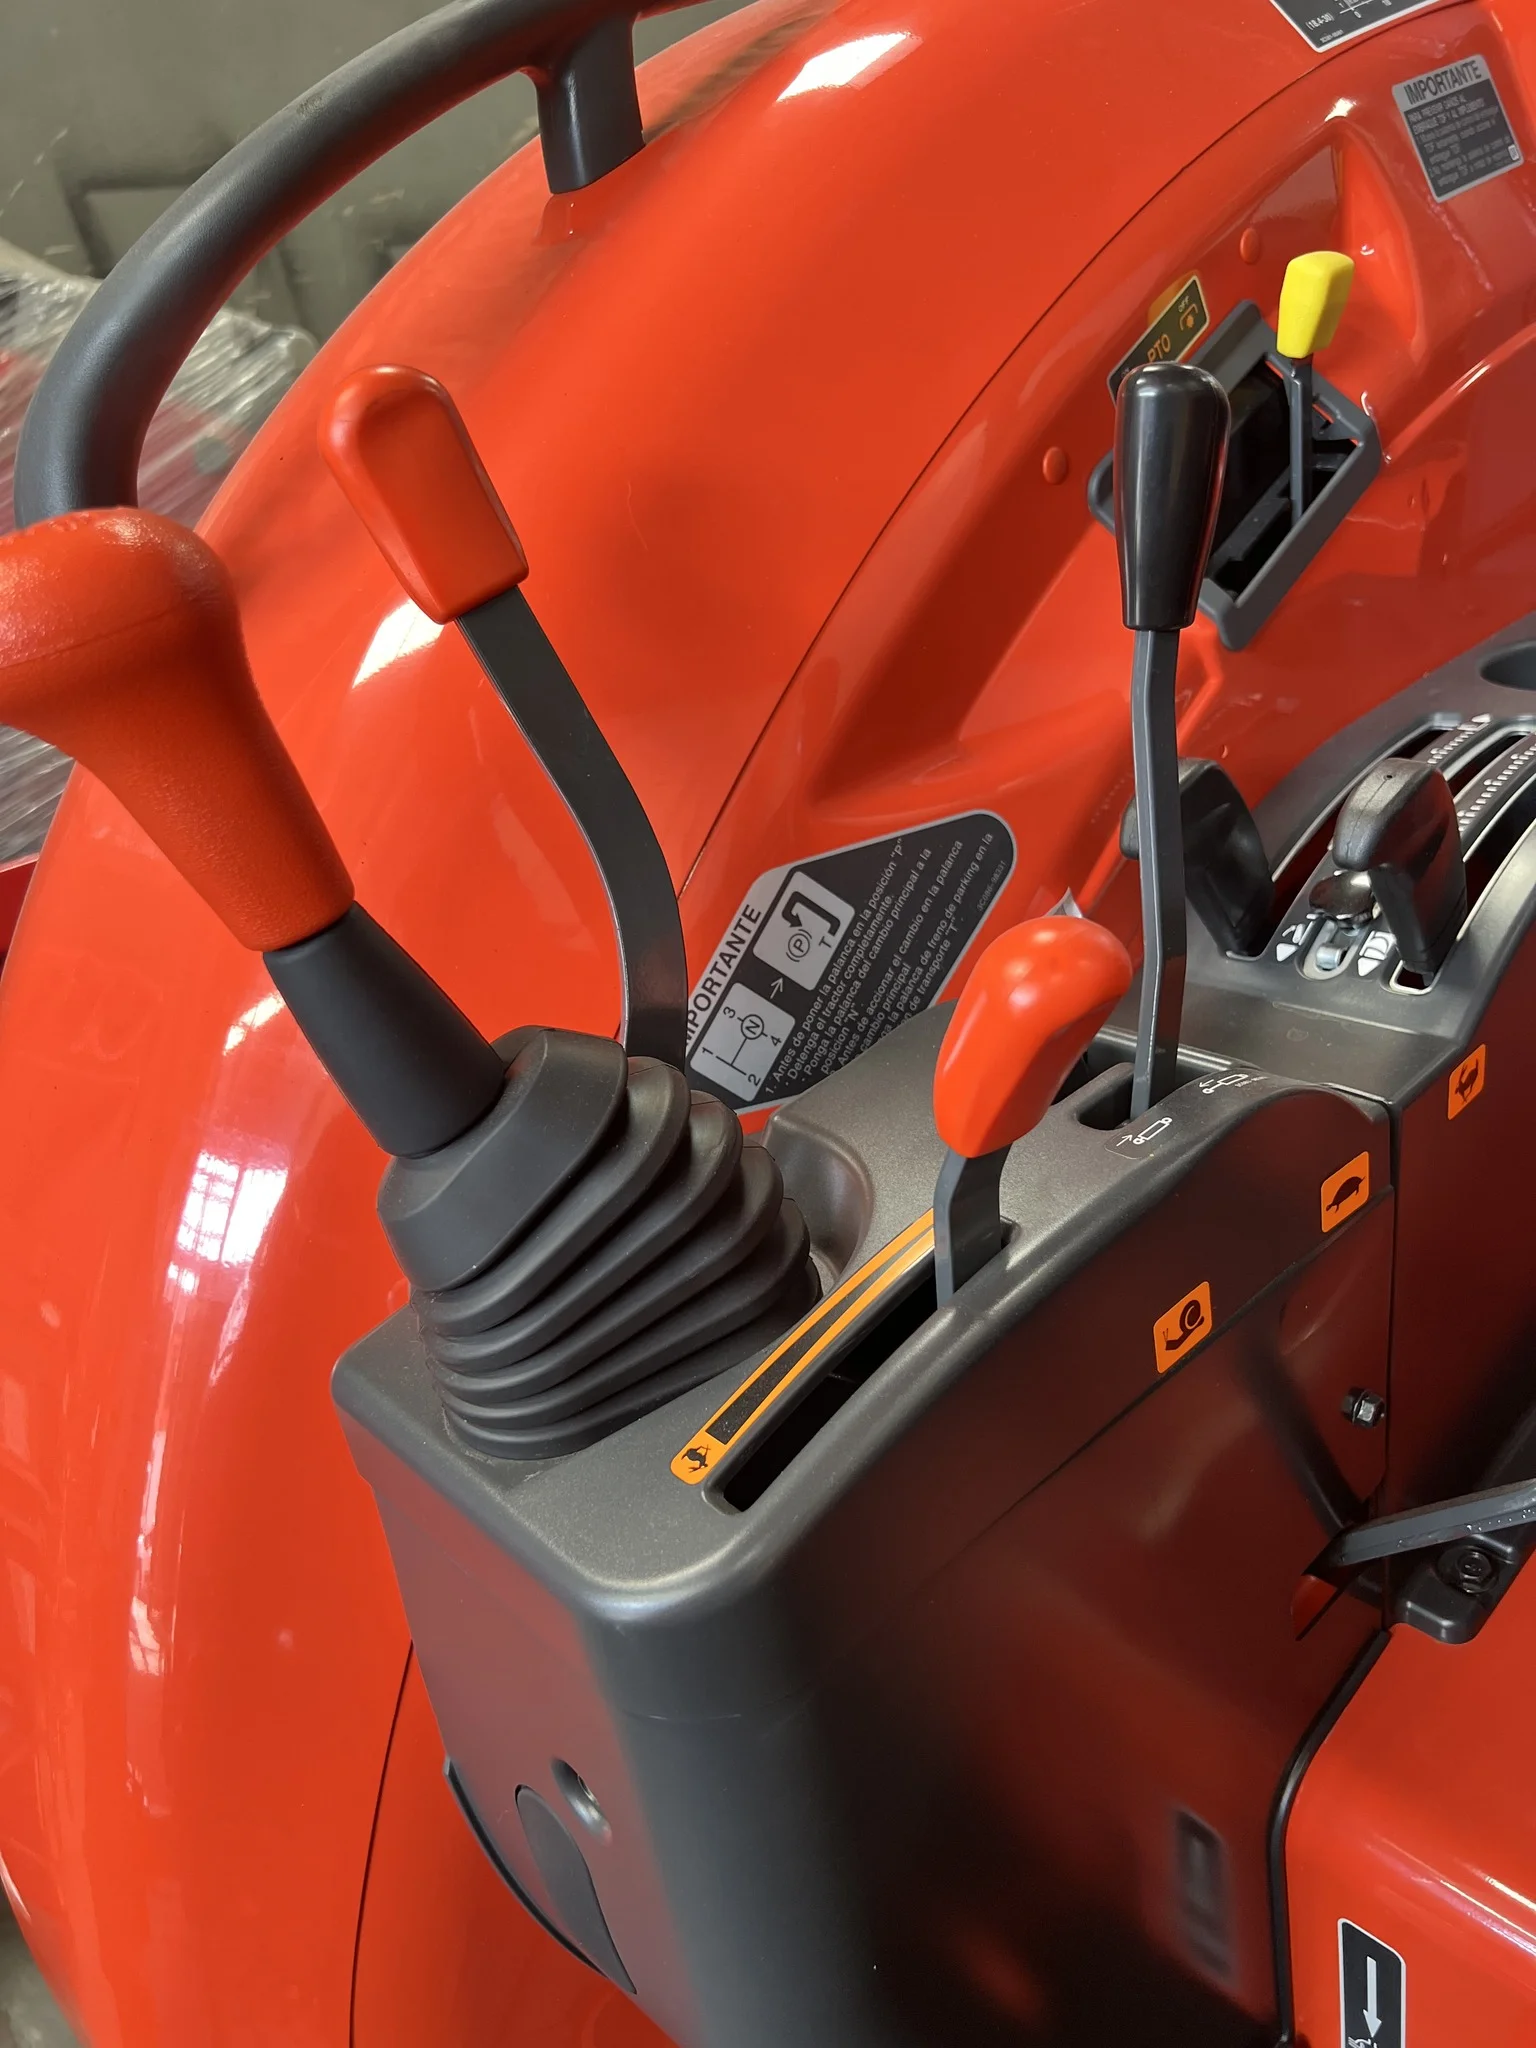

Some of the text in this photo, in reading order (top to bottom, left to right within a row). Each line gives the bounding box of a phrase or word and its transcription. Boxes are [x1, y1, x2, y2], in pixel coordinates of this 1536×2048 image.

[1403, 60, 1483, 106] IMPORTANTE
[1147, 333, 1171, 363] PTO
[818, 935, 832, 949] T
[837, 1033, 860, 1068] Antes
[857, 1016, 869, 1032] de
[866, 967, 895, 1016] accionar
[892, 953, 902, 967] el
[899, 914, 924, 955] cambio
[921, 897, 933, 913] en
[927, 885, 940, 897] la
[936, 840, 963, 886] palanca
[887, 1011, 900, 1023] la
[896, 966, 924, 1012] palanca
[920, 950, 932, 966] de
[927, 919, 948, 949] freno
[944, 903, 956, 919] de
[953, 861, 980, 904] parking
[975, 845, 987, 861] en
[981, 833, 993, 845] la
[686, 903, 762, 1046] PORTANTE
[772, 1048, 796, 1082] Antes
[792, 1031, 805, 1047] de
[801, 996, 824, 1032] poner
[818, 984, 832, 996] la
[827, 938, 857, 985] palanca
[852, 921, 865, 938] en
[859, 909, 872, 921] la
[868, 861, 897, 910] posición
[786, 893, 895, 1080] Detenga el tractor completamente.
[803, 848, 932, 1076] Ponga la palanca del cambio principal a la
[909, 995, 921, 1011] de
[916, 939, 951, 995] transporte
[722, 1006, 736, 1019] 3
[747, 1020, 761, 1035] N
[860, 1011, 886, 1055] cambio
[882, 962, 912, 1012] principal
[702, 1046, 714, 1055] 1
[770, 1035, 782, 1047] 4
[747, 1073, 762, 1087] 2
